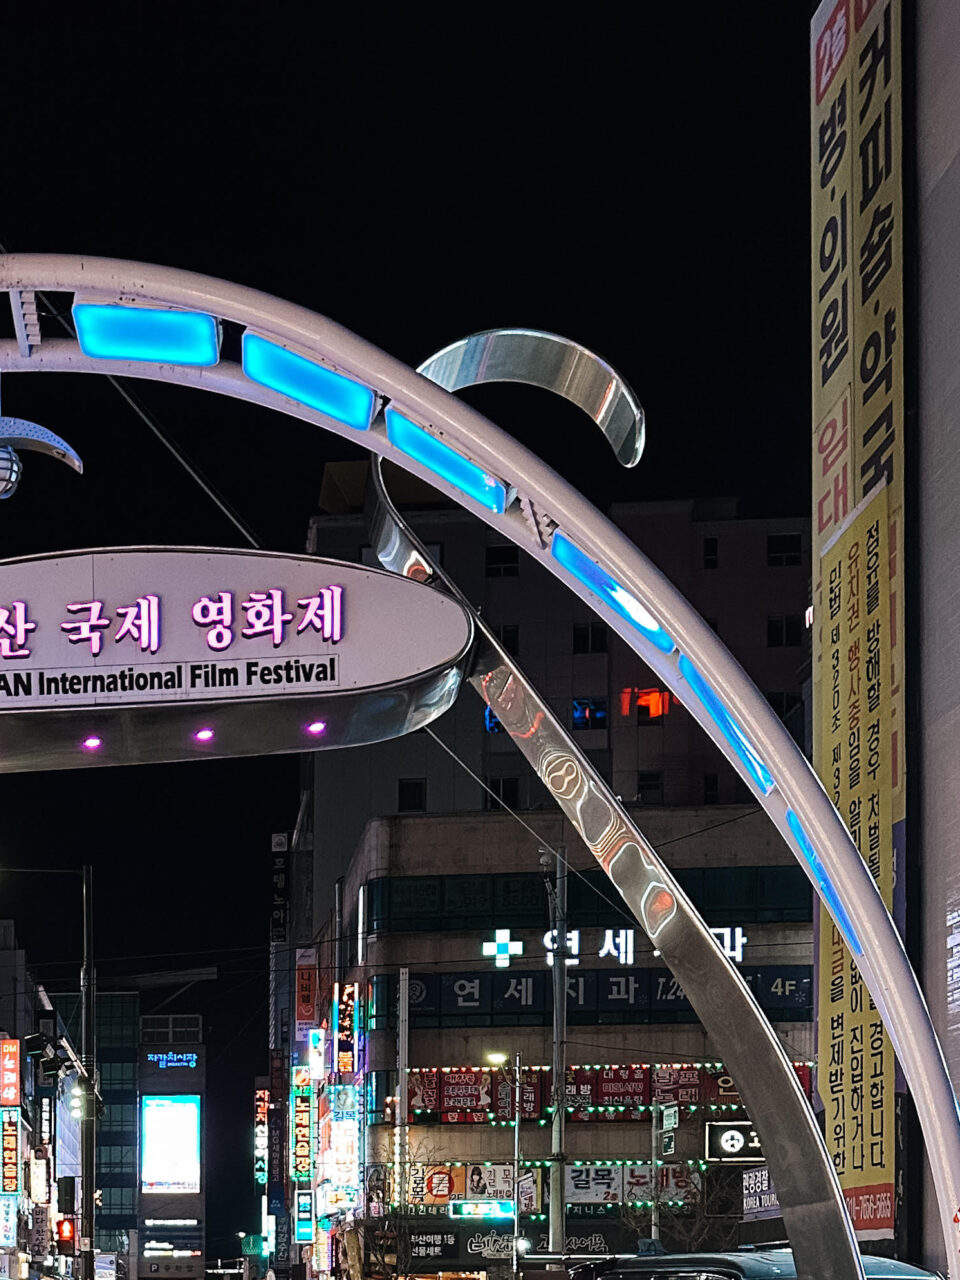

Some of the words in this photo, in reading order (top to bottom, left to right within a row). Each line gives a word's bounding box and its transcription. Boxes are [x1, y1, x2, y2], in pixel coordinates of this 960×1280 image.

[817, 397, 848, 535] 임대
[866, 519, 880, 616] 점유를
[829, 560, 841, 620] 민법
[847, 541, 860, 634] 유치권
[59, 594, 161, 654] 국제
[191, 585, 346, 650] 영화제
[38, 664, 184, 697] International
[189, 660, 239, 689] Film
[245, 656, 337, 686] Festival
[866, 619, 881, 713] 방해할
[867, 718, 880, 781] 경우
[543, 927, 748, 966] 연세과
[770, 977, 797, 997] 4F
[147, 1052, 198, 1068] 자갈치시장
[523, 1084, 535, 1111] 노래방
[850, 1024, 865, 1172] 진입하거나
[296, 1097, 311, 1172] 노래연습장
[410, 1168, 426, 1202] 길목
[487, 1168, 512, 1188] 길목
[570, 1168, 615, 1190] 길목
[743, 1169, 769, 1193] 관광경찰
[743, 1196, 760, 1210] KOREA
[411, 1234, 442, 1245] 부산여행
[537, 1233, 609, 1252] 고사어묵
